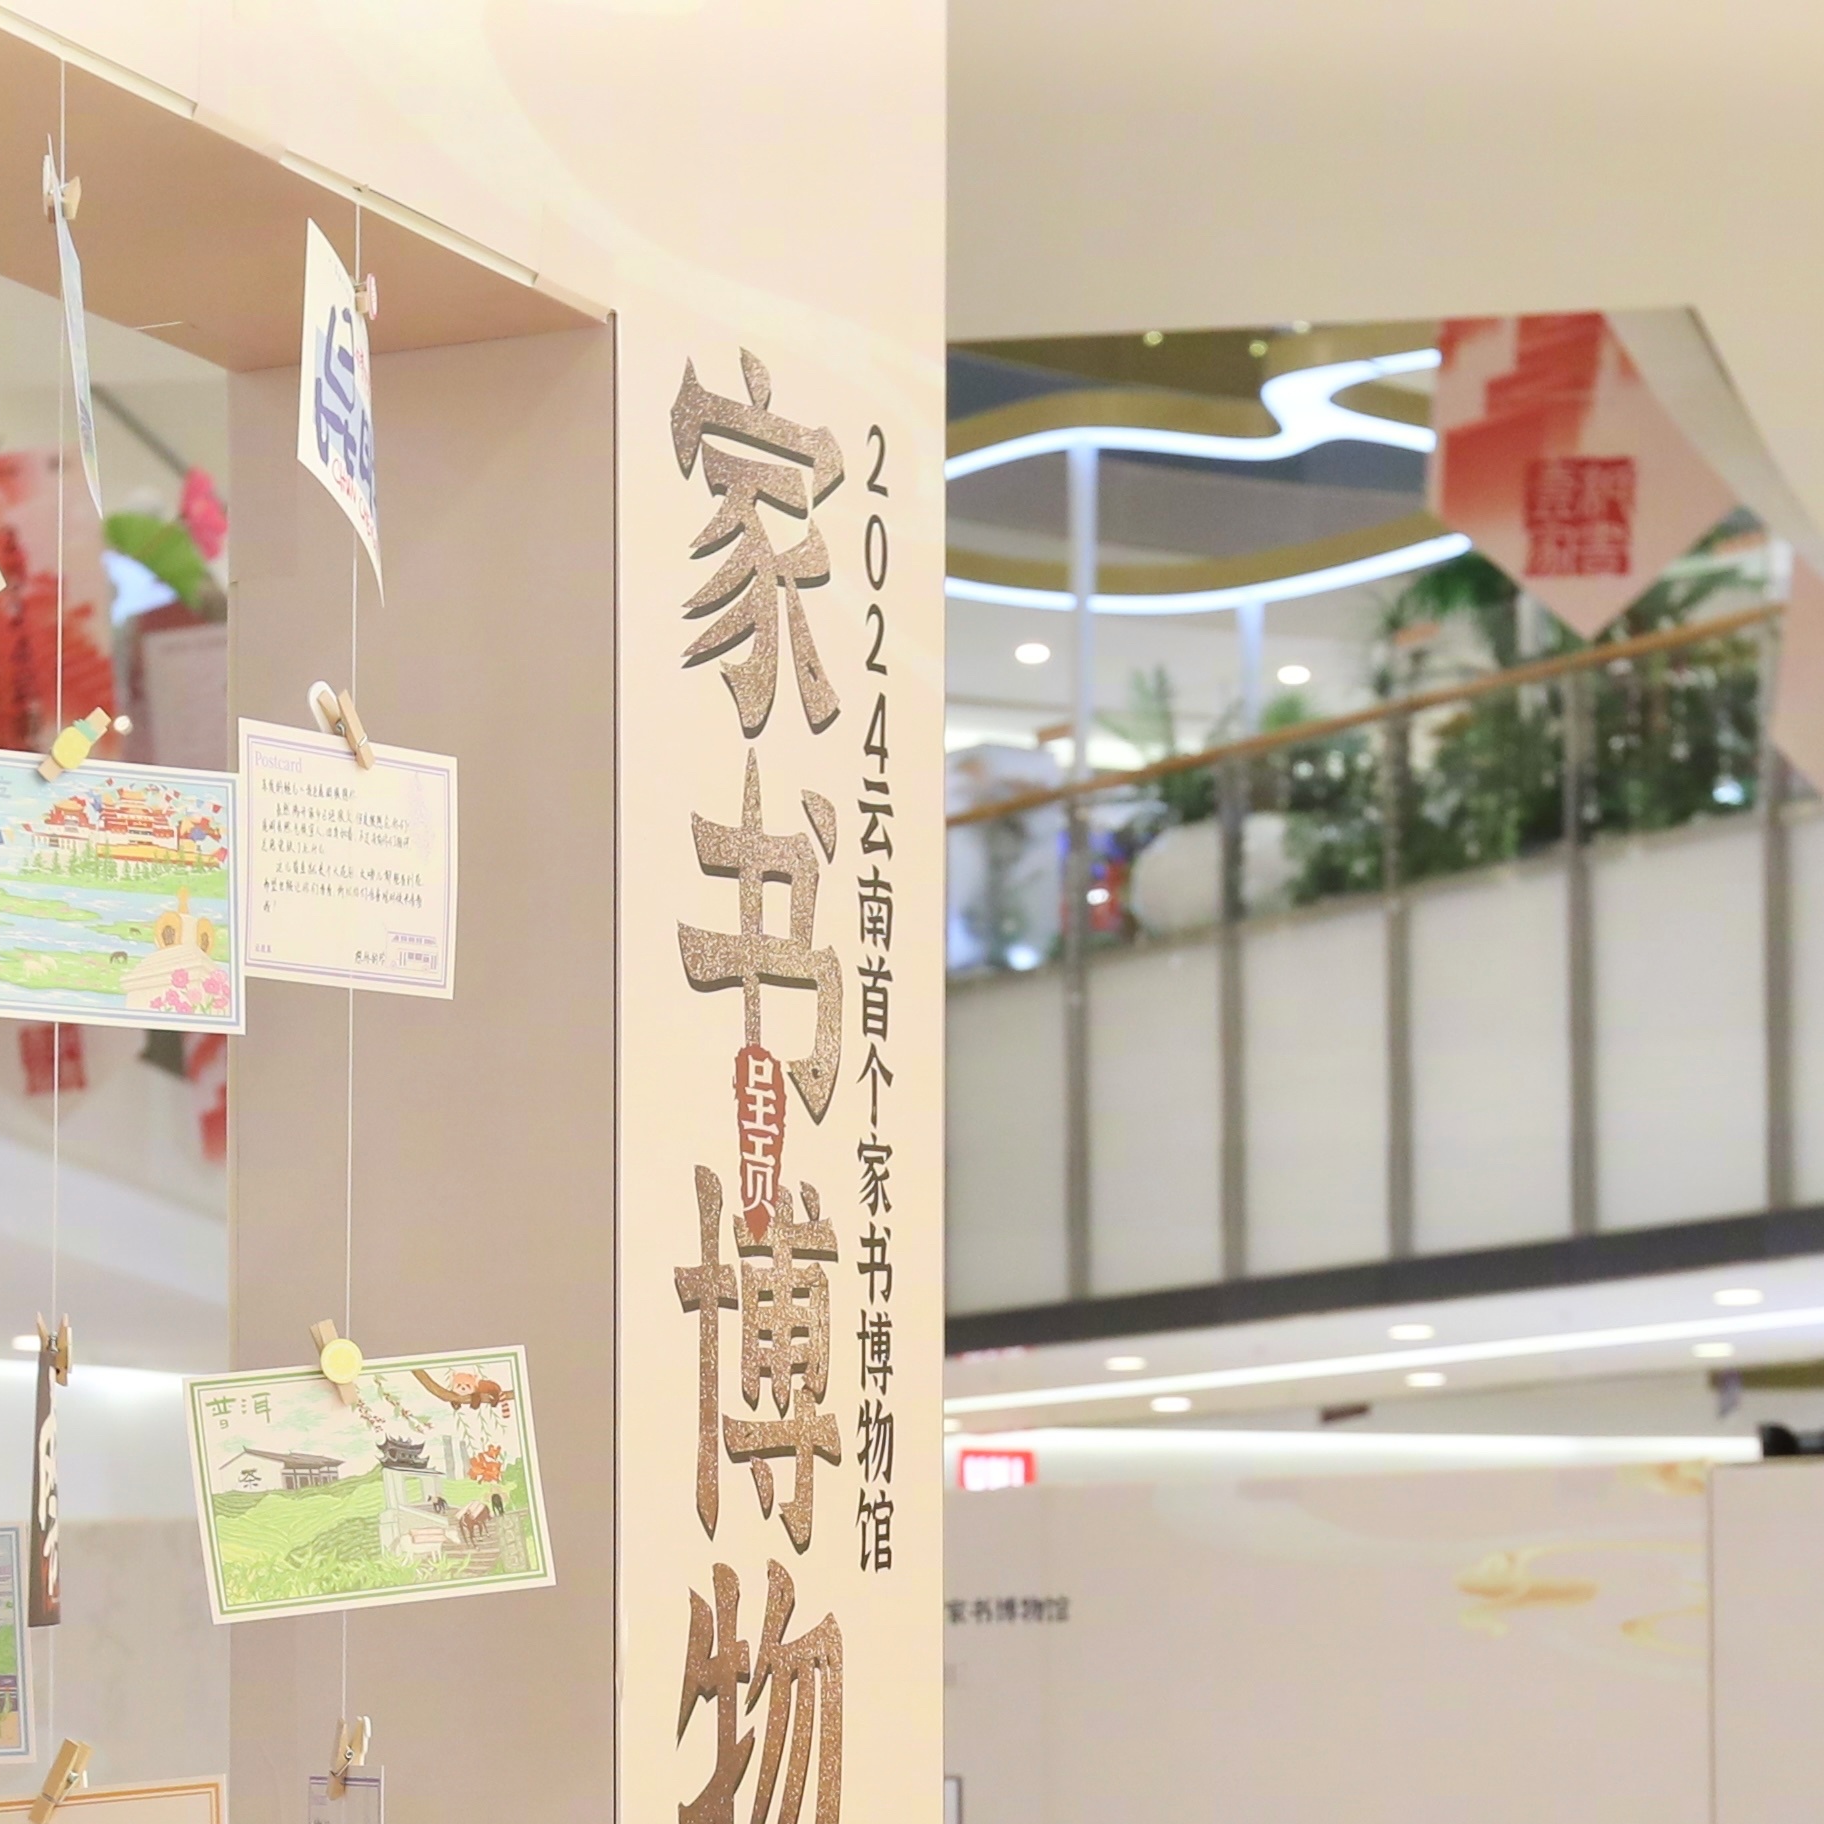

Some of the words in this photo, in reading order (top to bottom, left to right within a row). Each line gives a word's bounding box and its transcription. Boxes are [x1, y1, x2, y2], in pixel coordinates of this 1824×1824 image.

[255, 751, 303, 774] Postcard
[855, 424, 895, 1573] 2024云南首个家书博物馆
[742, 1055, 778, 1214] 呈贡
[205, 1392, 272, 1430] 普洱
[238, 1468, 263, 1489] 茶
